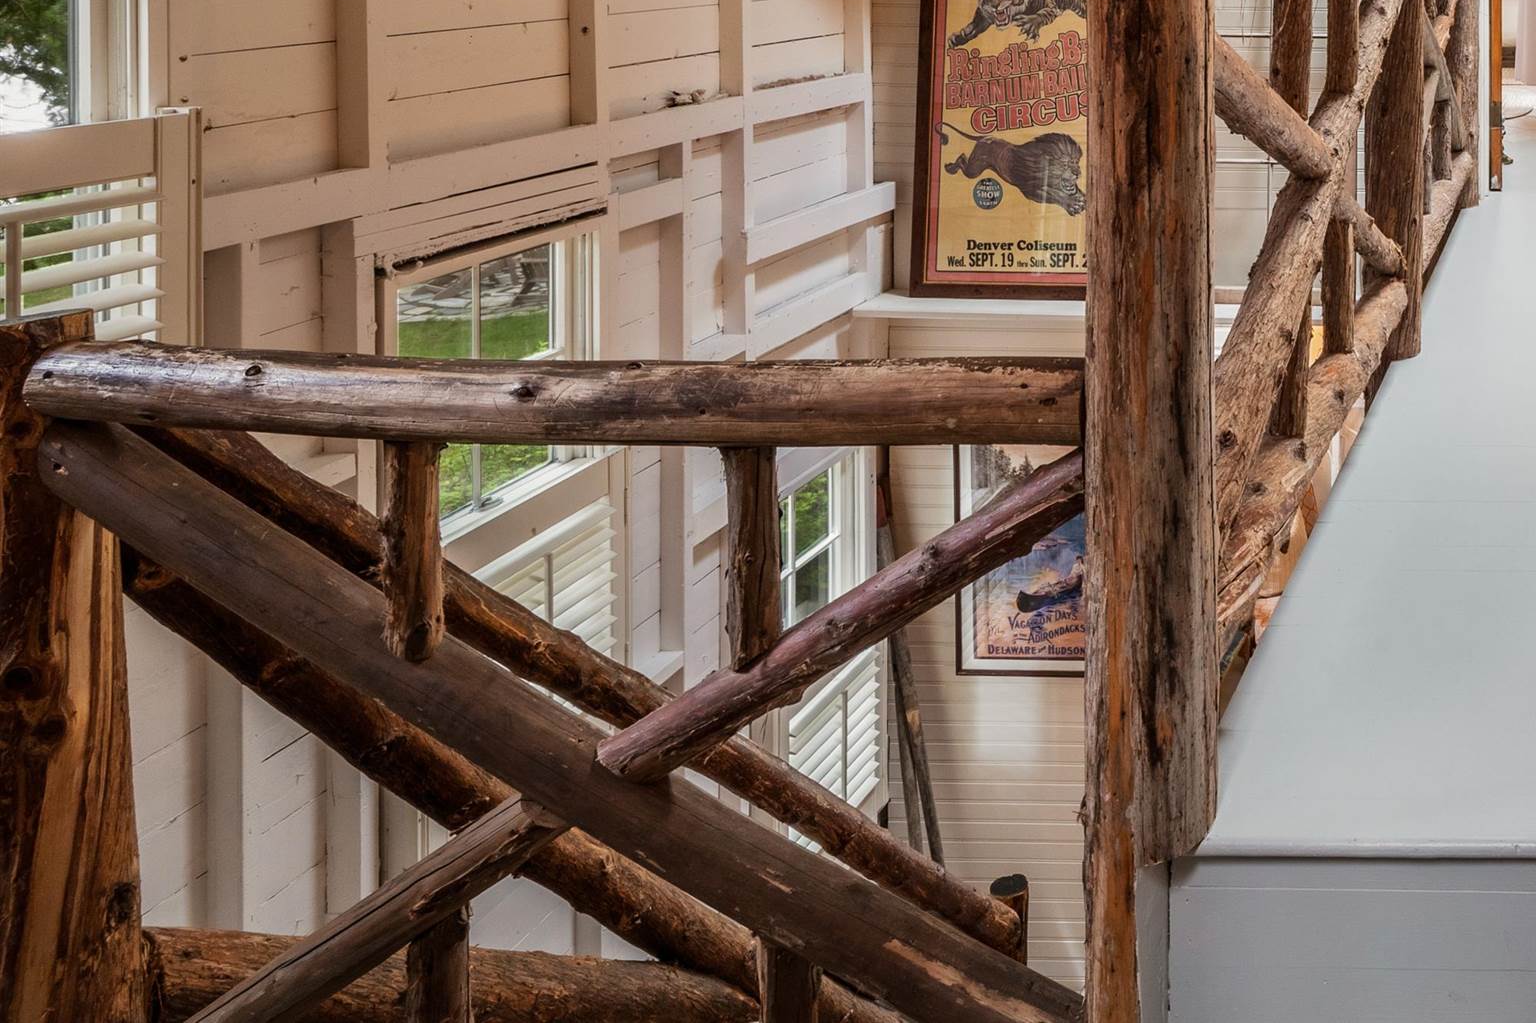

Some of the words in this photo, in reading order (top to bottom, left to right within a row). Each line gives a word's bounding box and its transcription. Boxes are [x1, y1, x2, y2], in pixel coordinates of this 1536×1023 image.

[947, 40, 1060, 82] Ringling
[946, 73, 1041, 109] BARNUM
[976, 189, 1001, 199] SHOW
[966, 239, 1014, 251] Denver
[1017, 239, 1078, 251] Coliseum
[947, 255, 967, 267] Wed.
[969, 252, 998, 267] SEPT.
[1001, 252, 1014, 267] 19
[1030, 256, 1047, 268] Sun.
[1050, 253, 1079, 268] SEPT.
[988, 644, 1037, 655] DELAWARE
